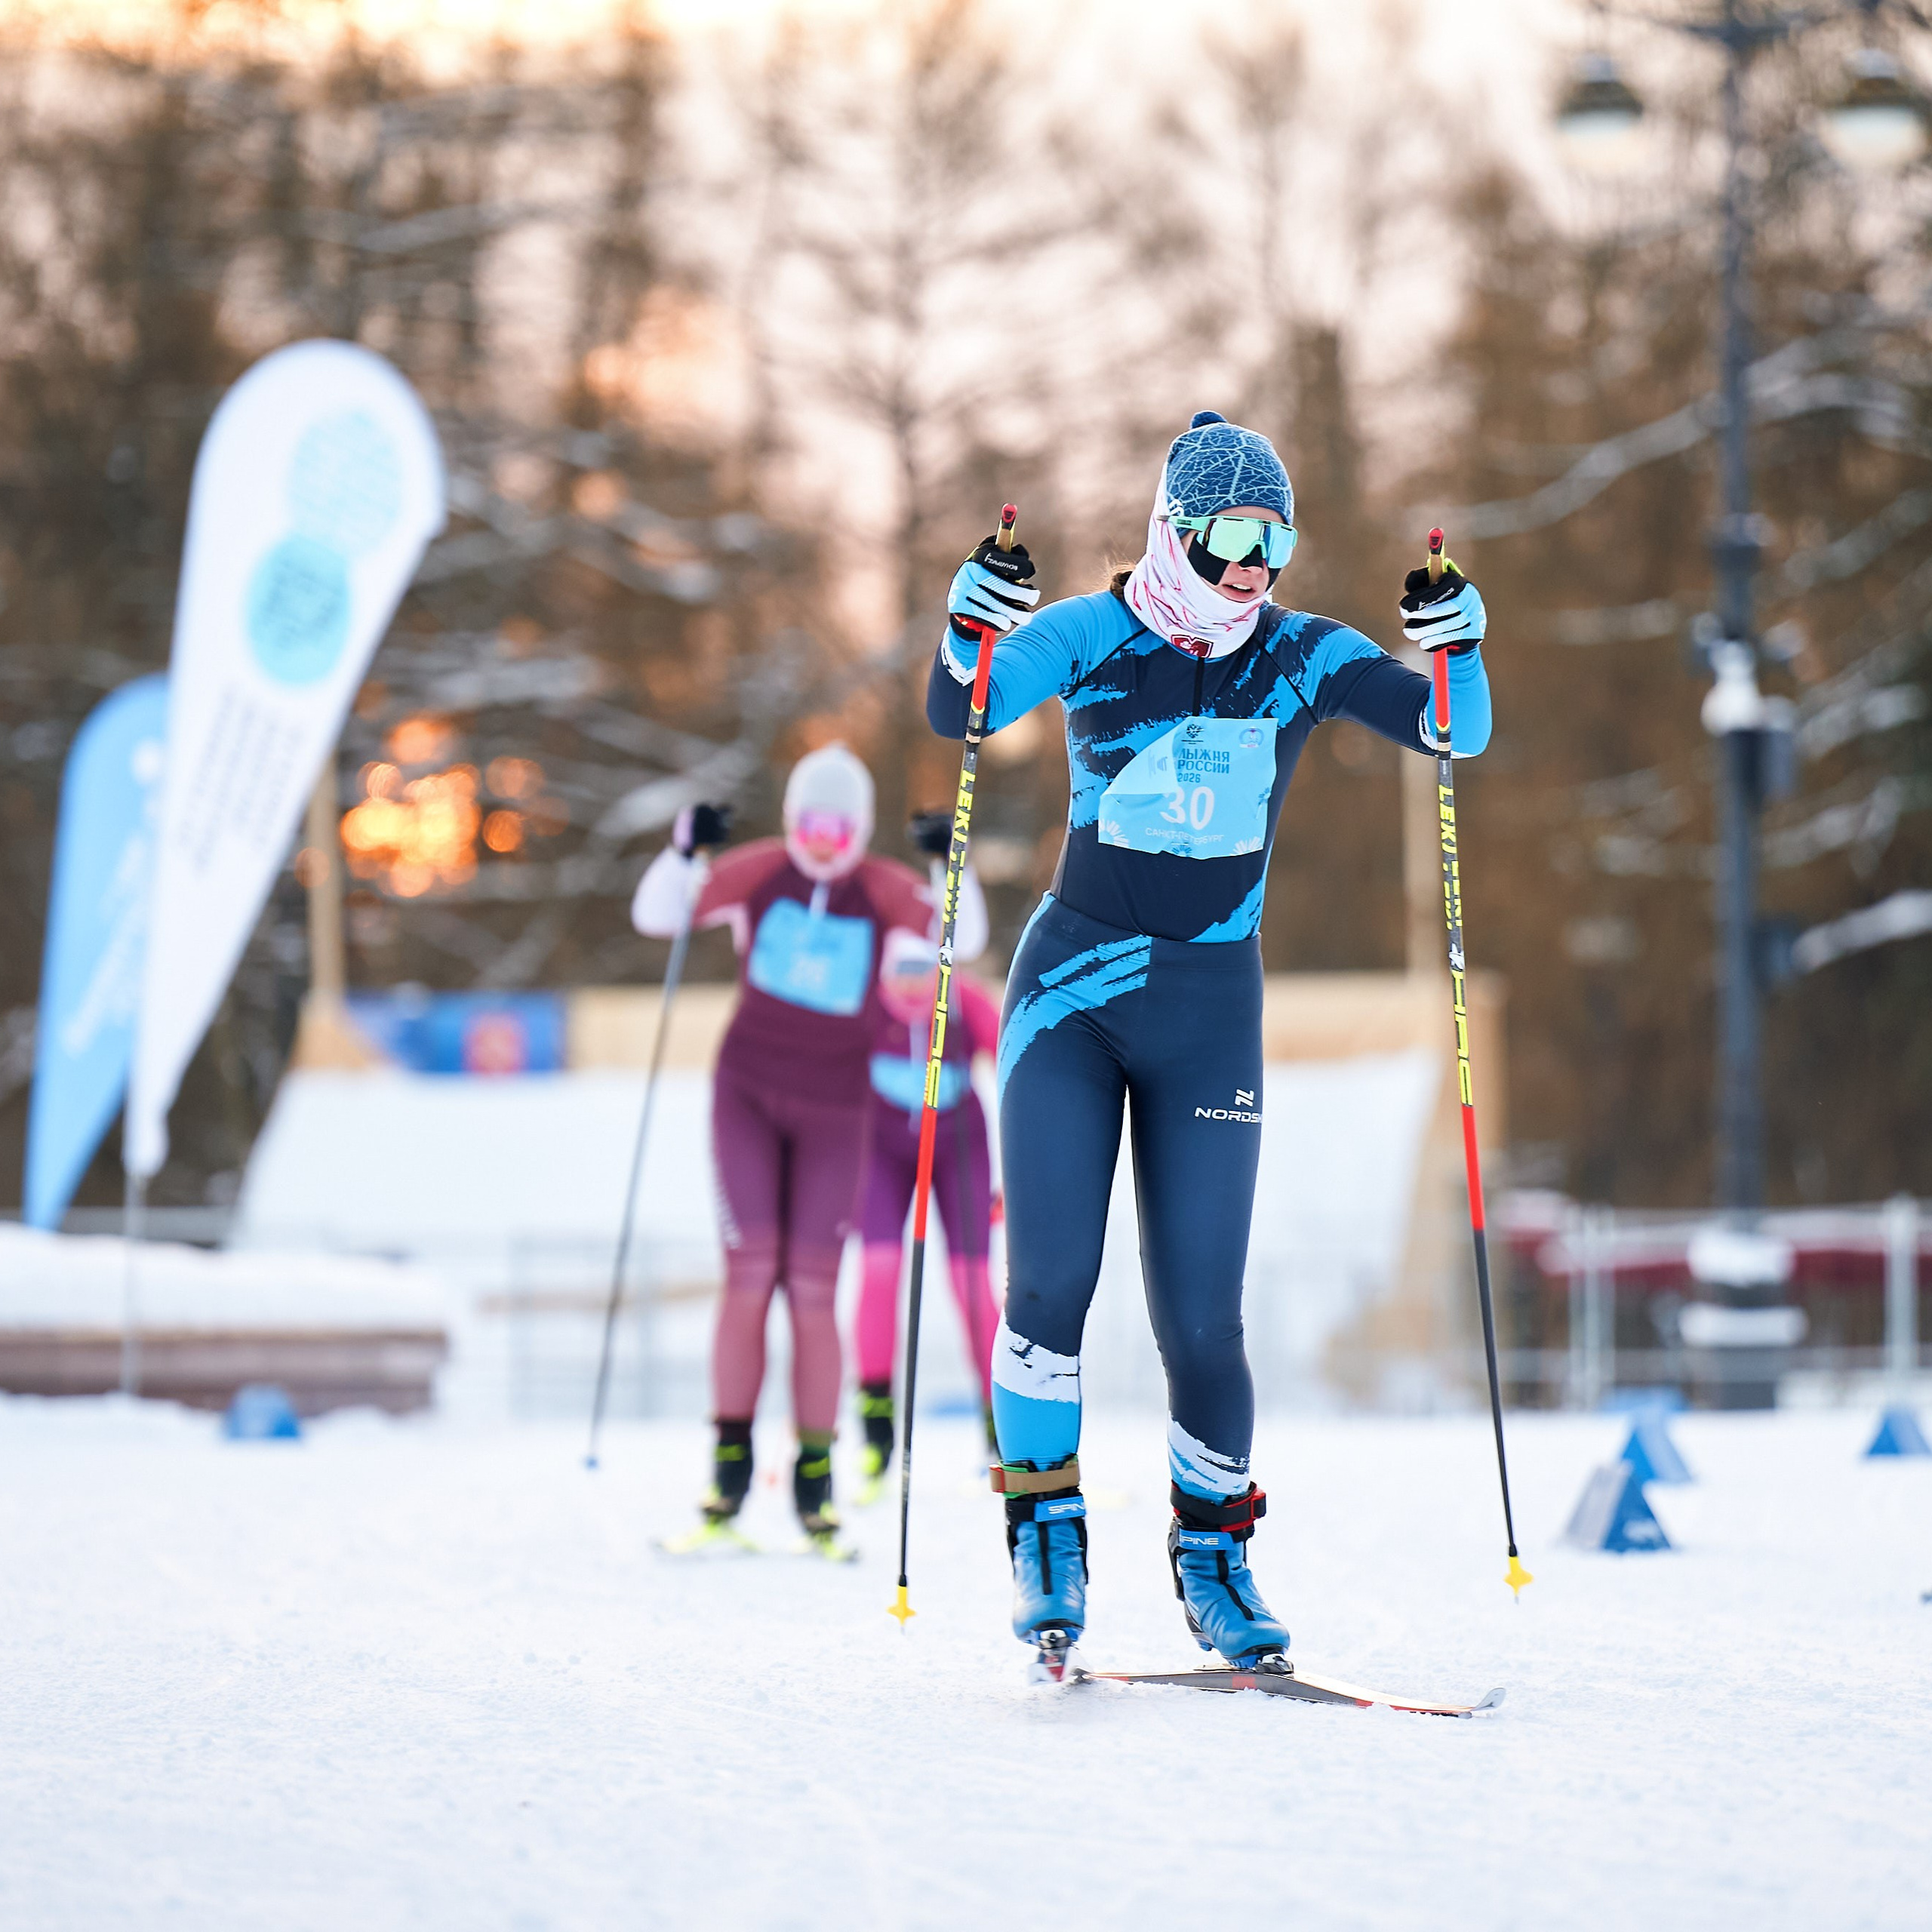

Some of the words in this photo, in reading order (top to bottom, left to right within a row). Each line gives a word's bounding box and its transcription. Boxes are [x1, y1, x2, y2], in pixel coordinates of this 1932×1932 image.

[1178, 748, 1229, 762] ЛЫЖНЯ
[1177, 759, 1229, 774] РОССИИ
[1177, 773, 1201, 783] 2026
[952, 769, 976, 843] LEKI
[1159, 786, 1214, 830] 30
[1438, 784, 1457, 854] LEKI
[1179, 1534, 1220, 1545] PINE
